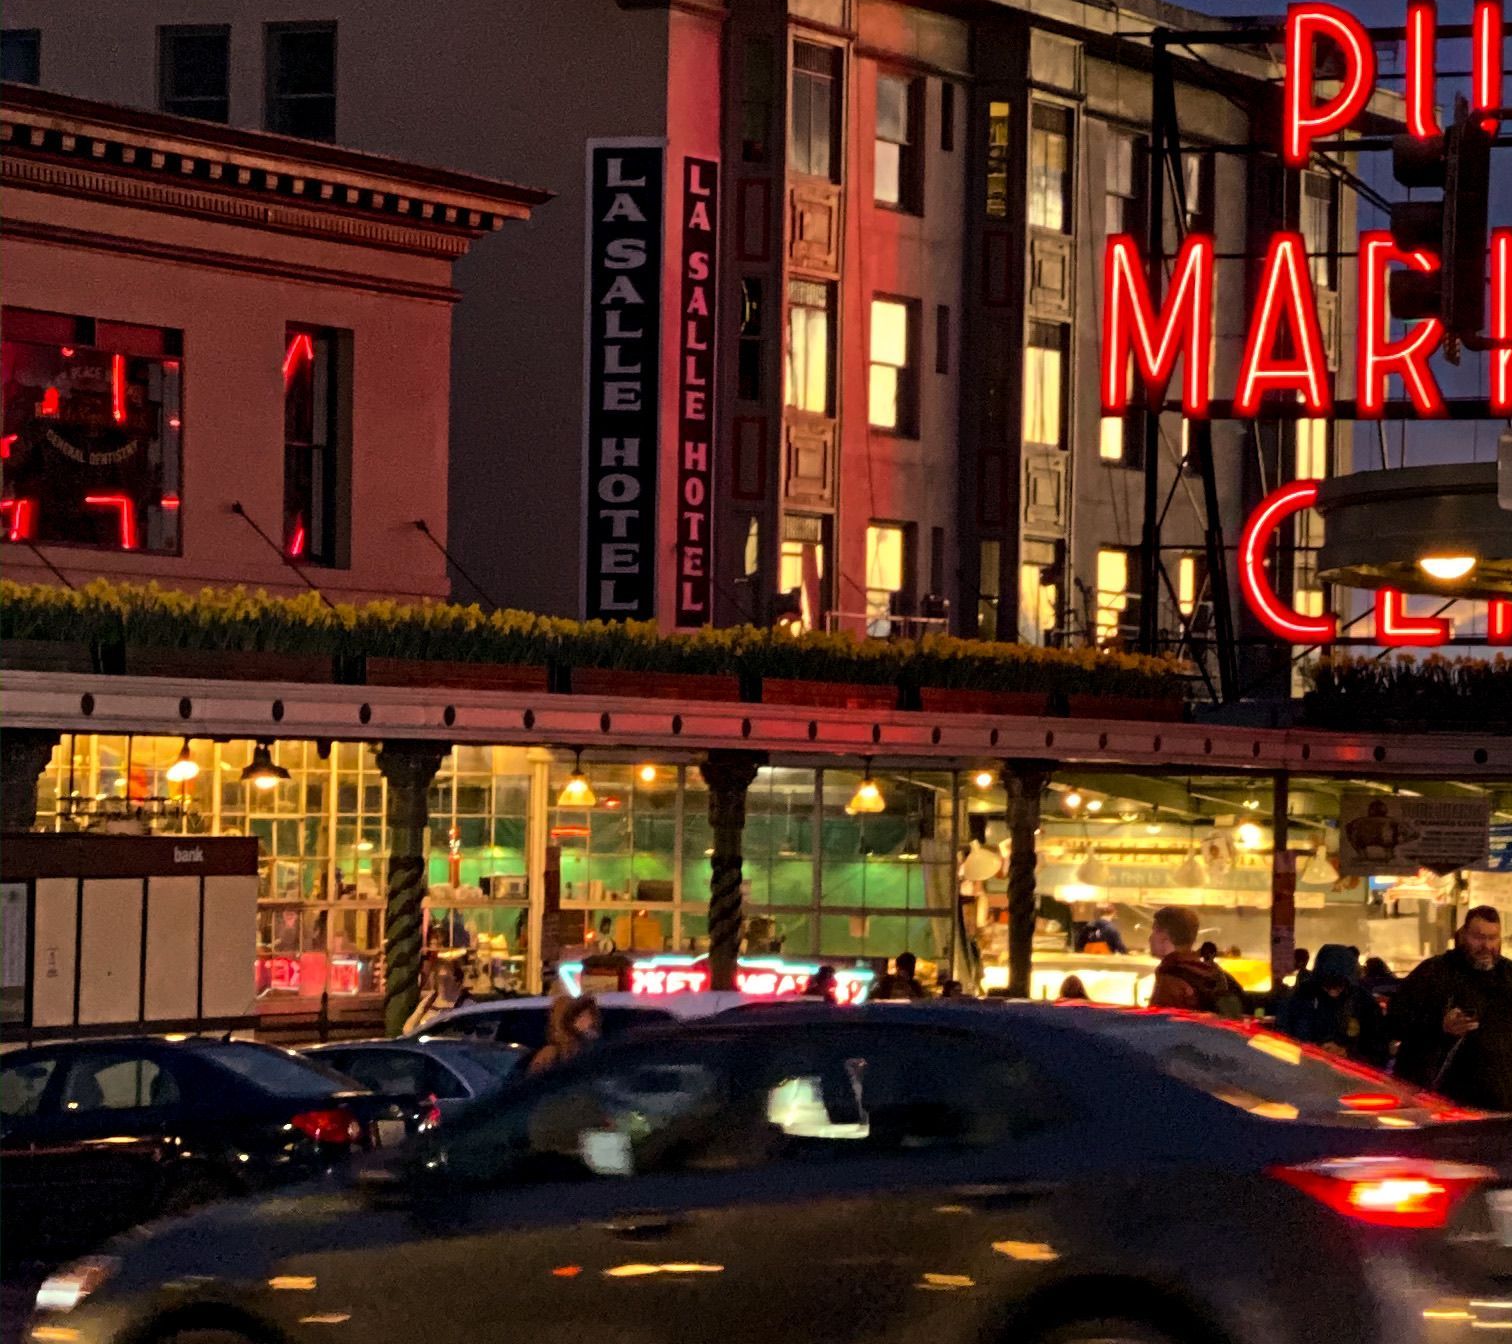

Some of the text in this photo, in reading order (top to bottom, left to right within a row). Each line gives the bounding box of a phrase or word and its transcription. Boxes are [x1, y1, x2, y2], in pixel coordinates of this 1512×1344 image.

[597, 157, 647, 612] LA SALLE HOTEL
[681, 164, 711, 612] LA SALLE HOTEL
[173, 846, 203, 863] bank
